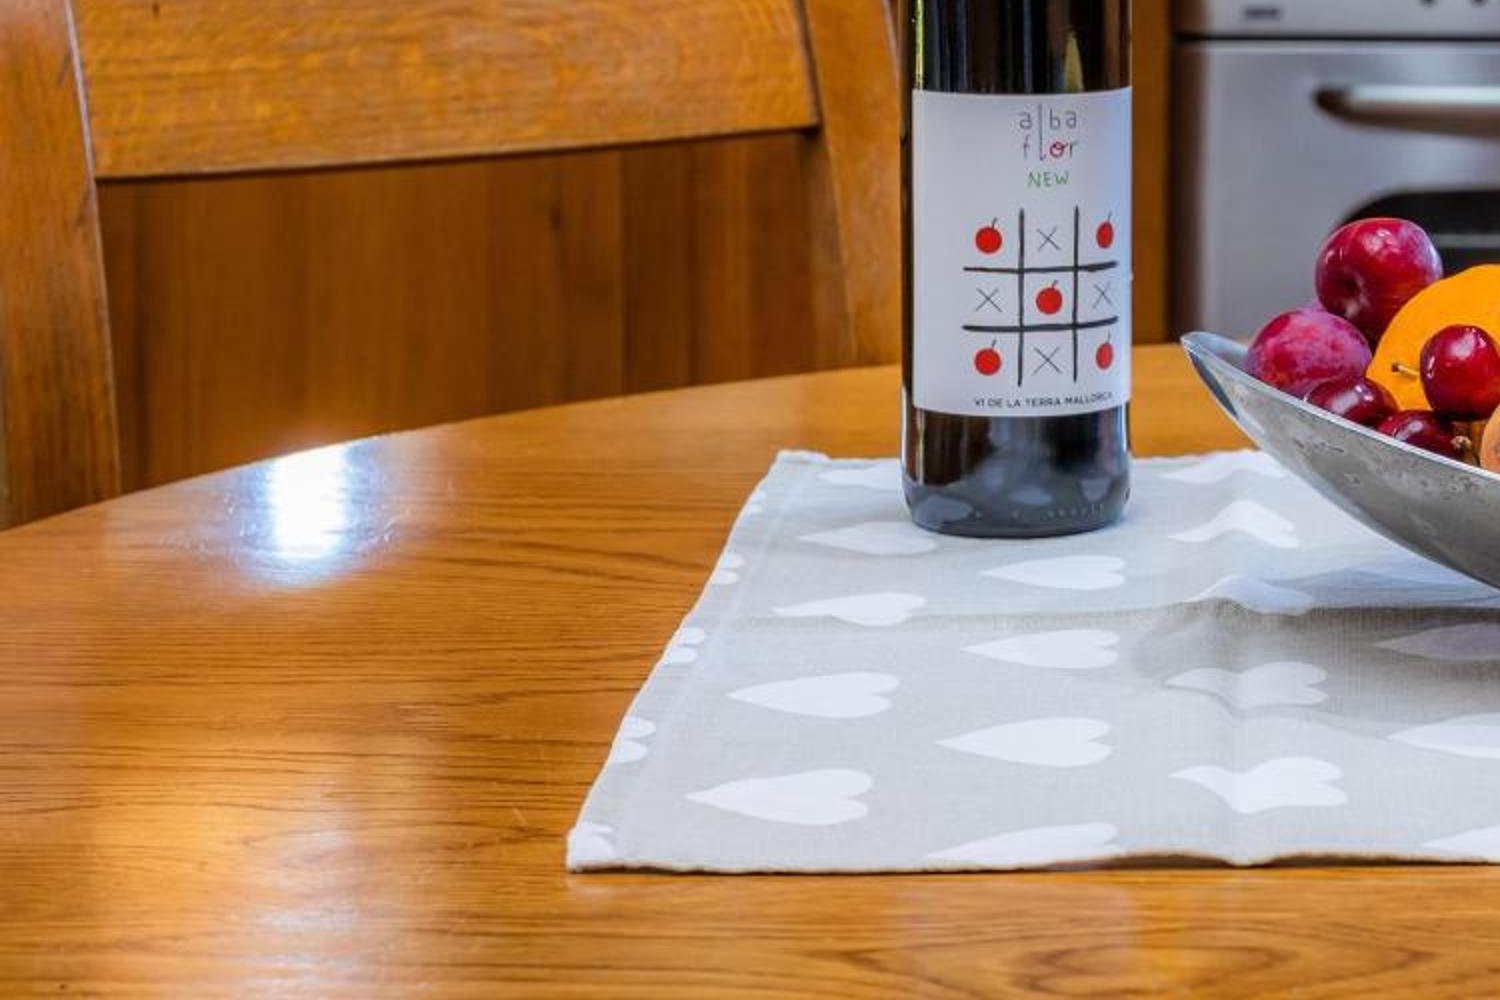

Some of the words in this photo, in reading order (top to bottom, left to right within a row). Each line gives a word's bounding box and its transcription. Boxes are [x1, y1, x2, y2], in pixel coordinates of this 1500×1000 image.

[1018, 104, 1077, 130] alba
[1027, 170, 1070, 187] NEW
[987, 397, 1003, 408] DE
[1006, 398, 1021, 408] LA
[1025, 397, 1061, 408] TERRA
